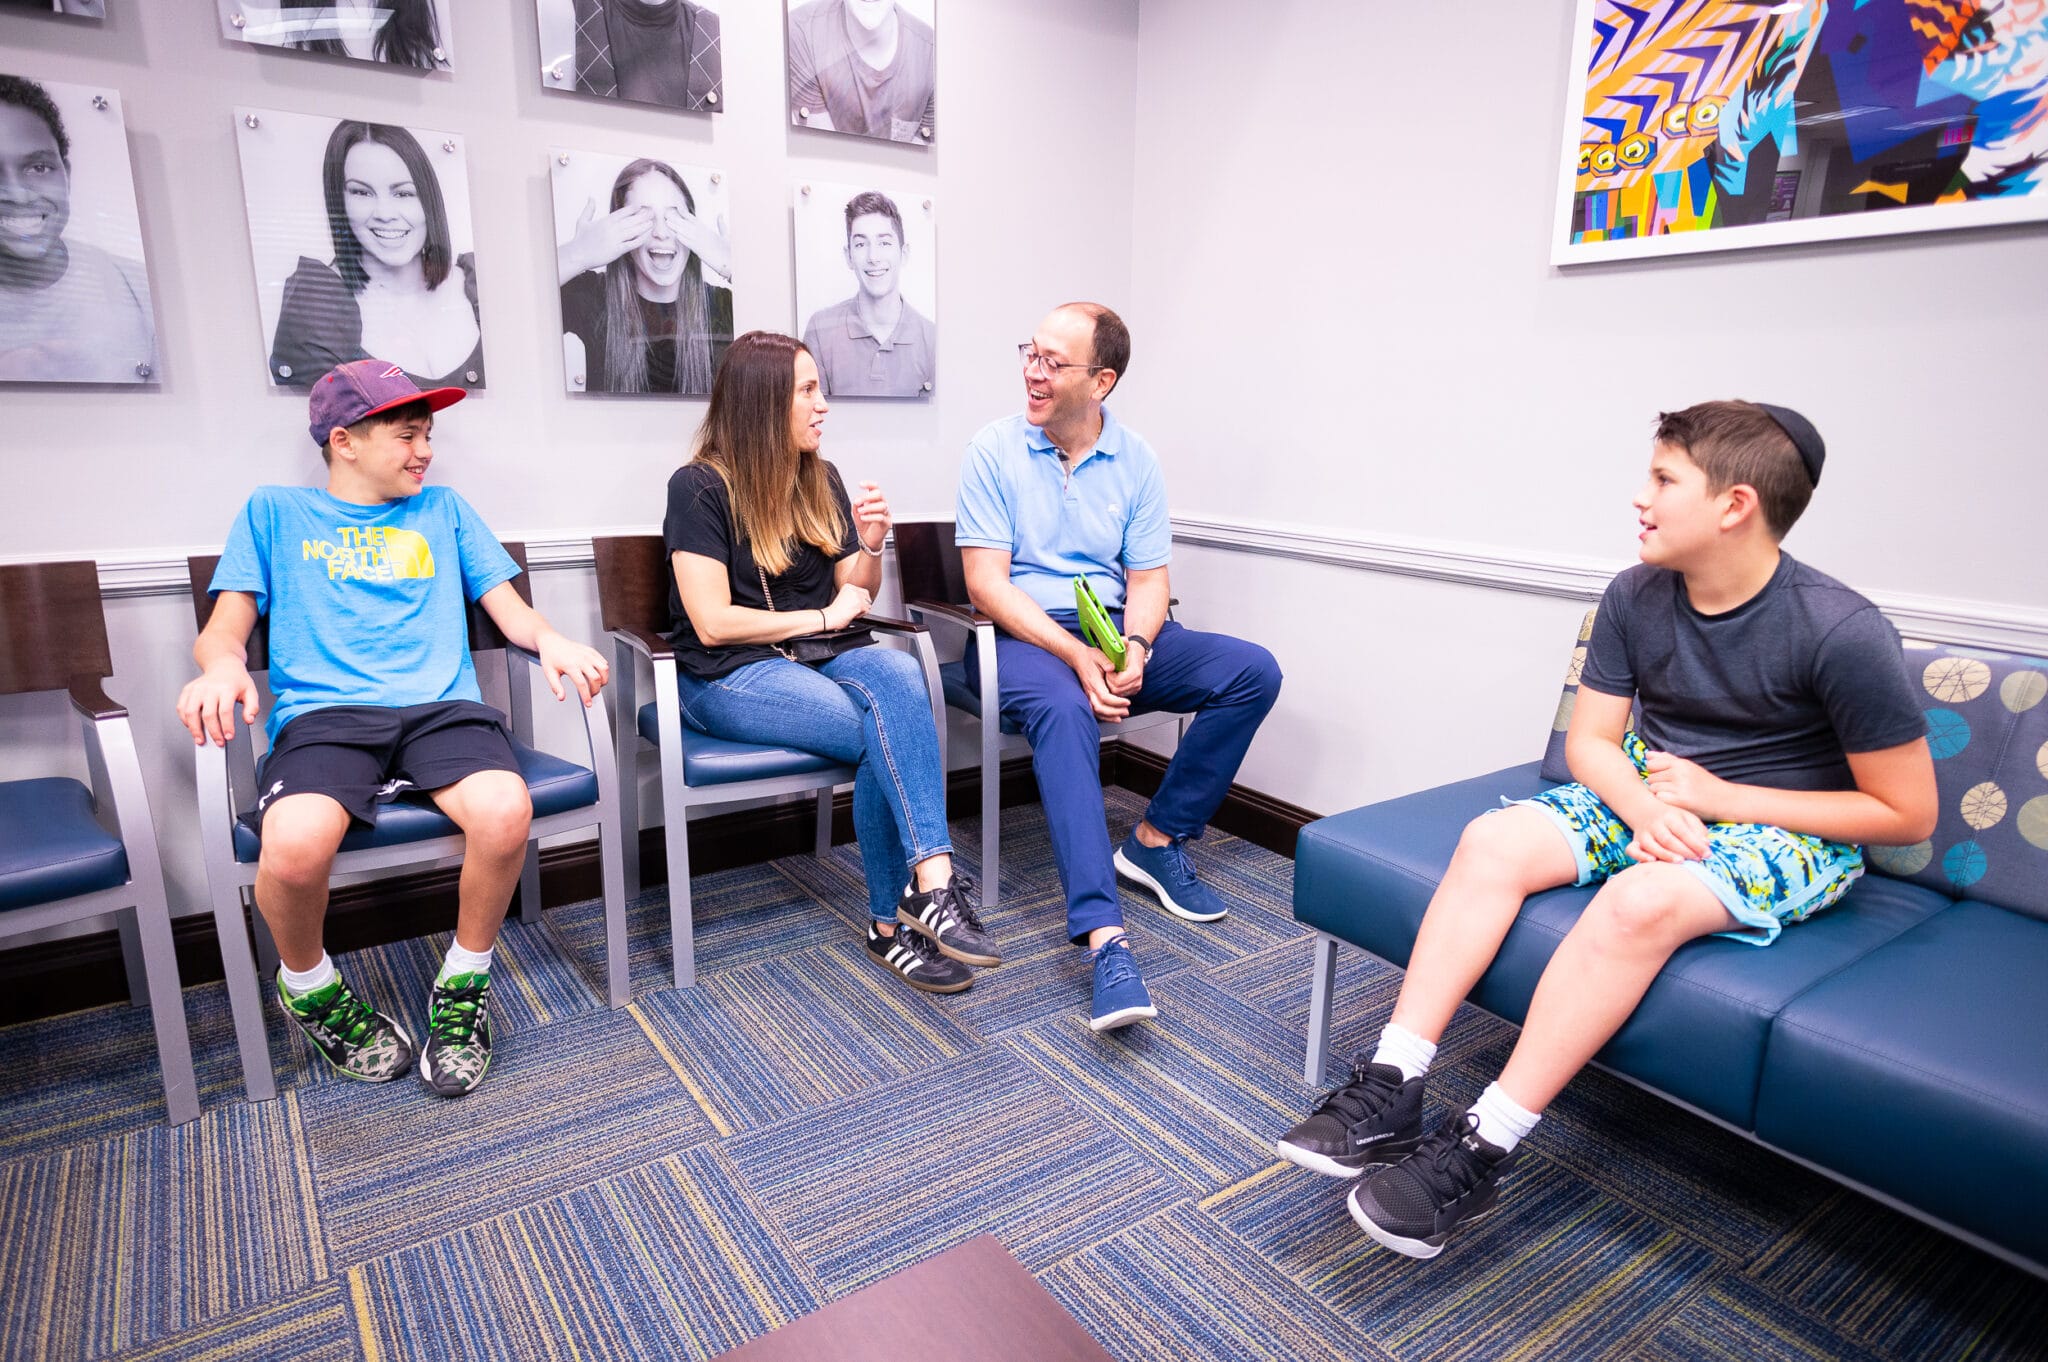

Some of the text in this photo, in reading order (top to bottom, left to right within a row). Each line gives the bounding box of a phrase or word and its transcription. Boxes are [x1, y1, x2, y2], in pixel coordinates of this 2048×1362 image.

[337, 526, 384, 547] THE
[302, 539, 389, 567] NORTH
[327, 559, 393, 582] FACE
